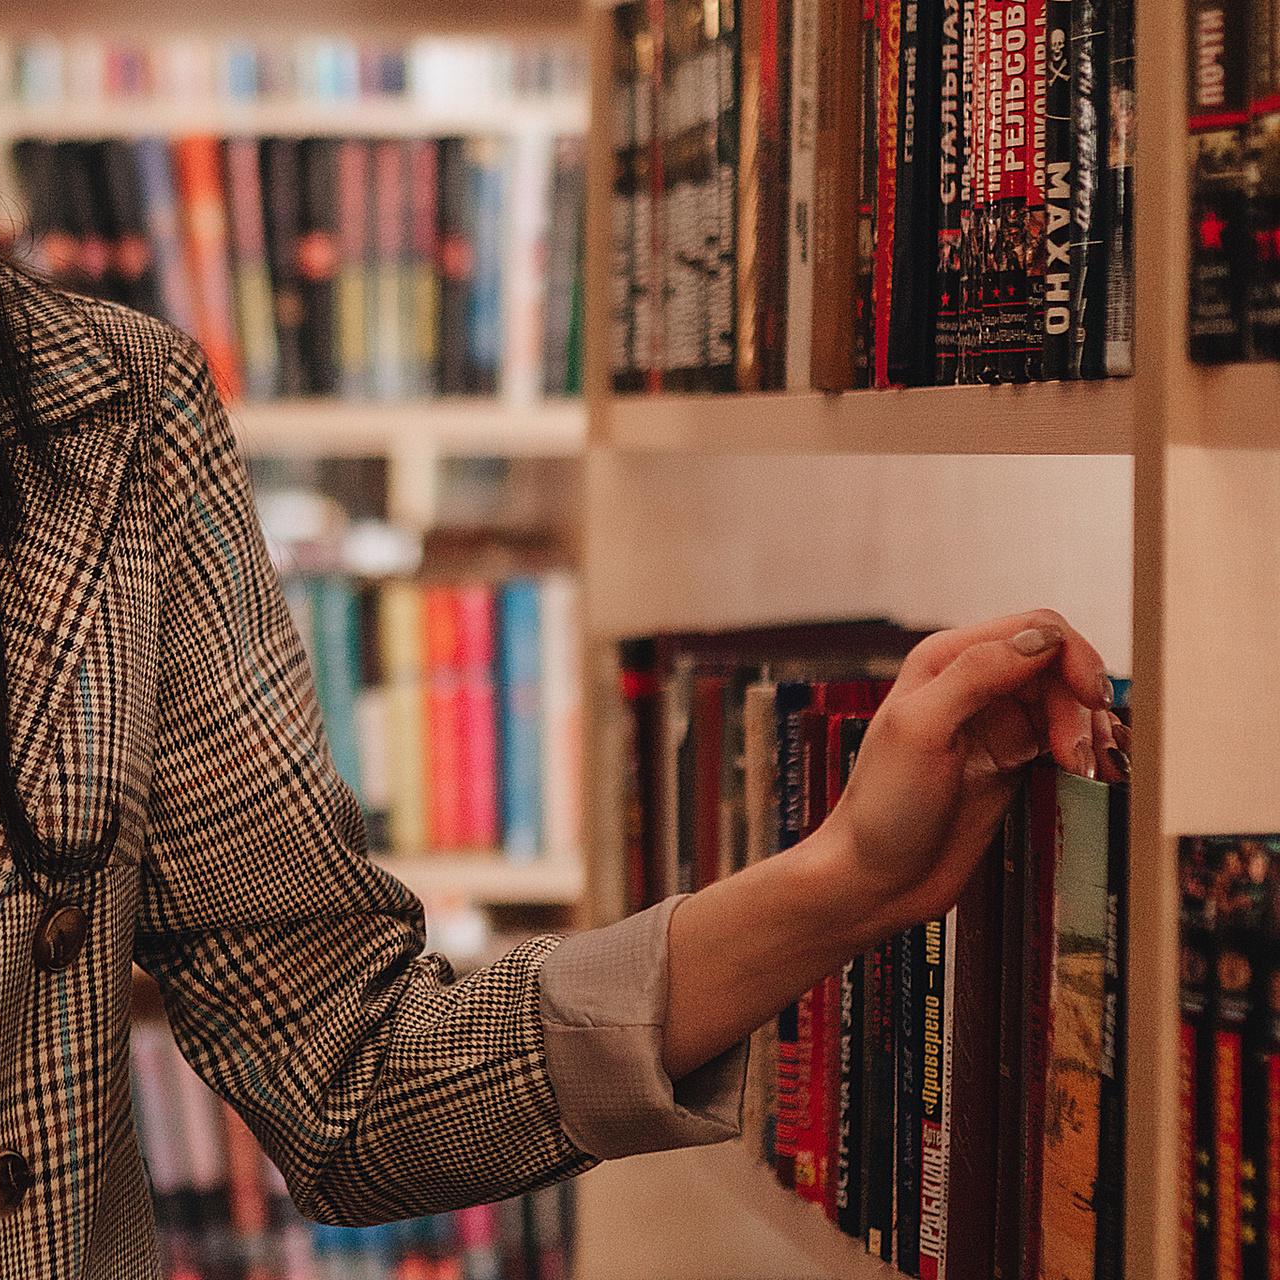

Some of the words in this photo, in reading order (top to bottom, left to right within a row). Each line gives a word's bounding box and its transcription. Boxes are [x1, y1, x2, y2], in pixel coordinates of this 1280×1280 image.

[903, 46, 918, 163] ГЕОРГИЙ
[988, 10, 1003, 193] ШТРАФНИКИ
[1197, 10, 1223, 106] ПОЧТИ
[1046, 161, 1071, 335] МАХНО
[921, 994, 942, 1115] «Проверено
